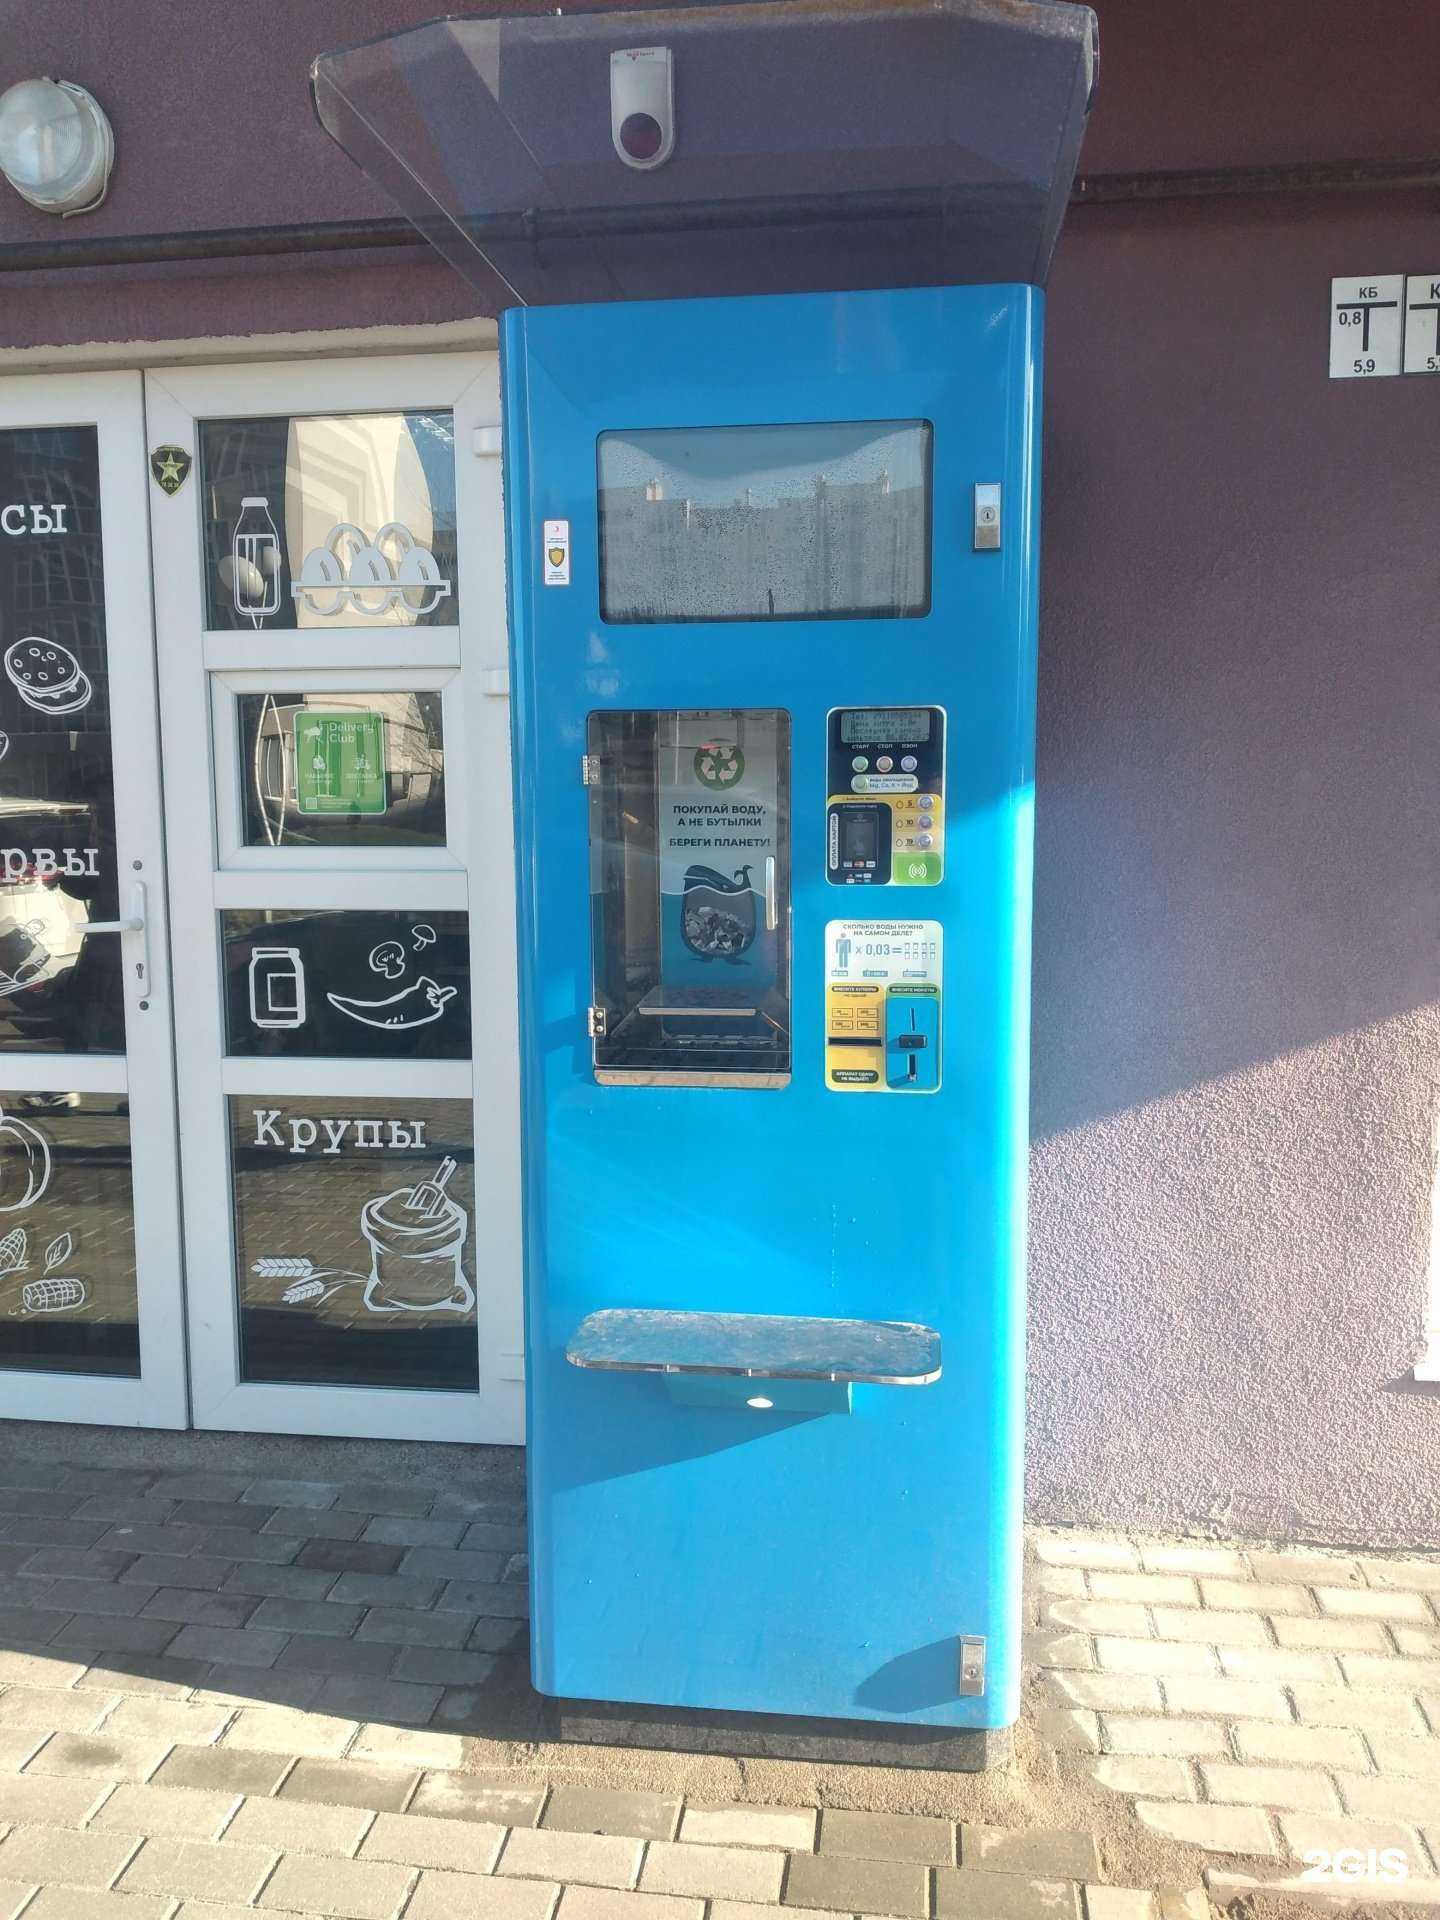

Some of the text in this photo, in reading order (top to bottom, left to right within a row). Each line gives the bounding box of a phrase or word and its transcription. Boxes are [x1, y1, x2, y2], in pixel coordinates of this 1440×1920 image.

[1359, 287, 1378, 299] КБ
[1338, 311, 1361, 327] 0,8
[1353, 358, 1376, 374] 5,9
[1426, 356, 1440, 371] 5,
[329, 722, 375, 734] Delivery
[329, 733, 355, 743] Club
[673, 803, 767, 816] ПОКУПАЙ ВОДУ,
[677, 818, 762, 827] А НЕ БУТЫЛКИ
[669, 838, 770, 847] БЕРЕГИ ПЛАНЕТУ!
[865, 943, 890, 957] 0,03
[253, 1110, 426, 1154] Крупы
